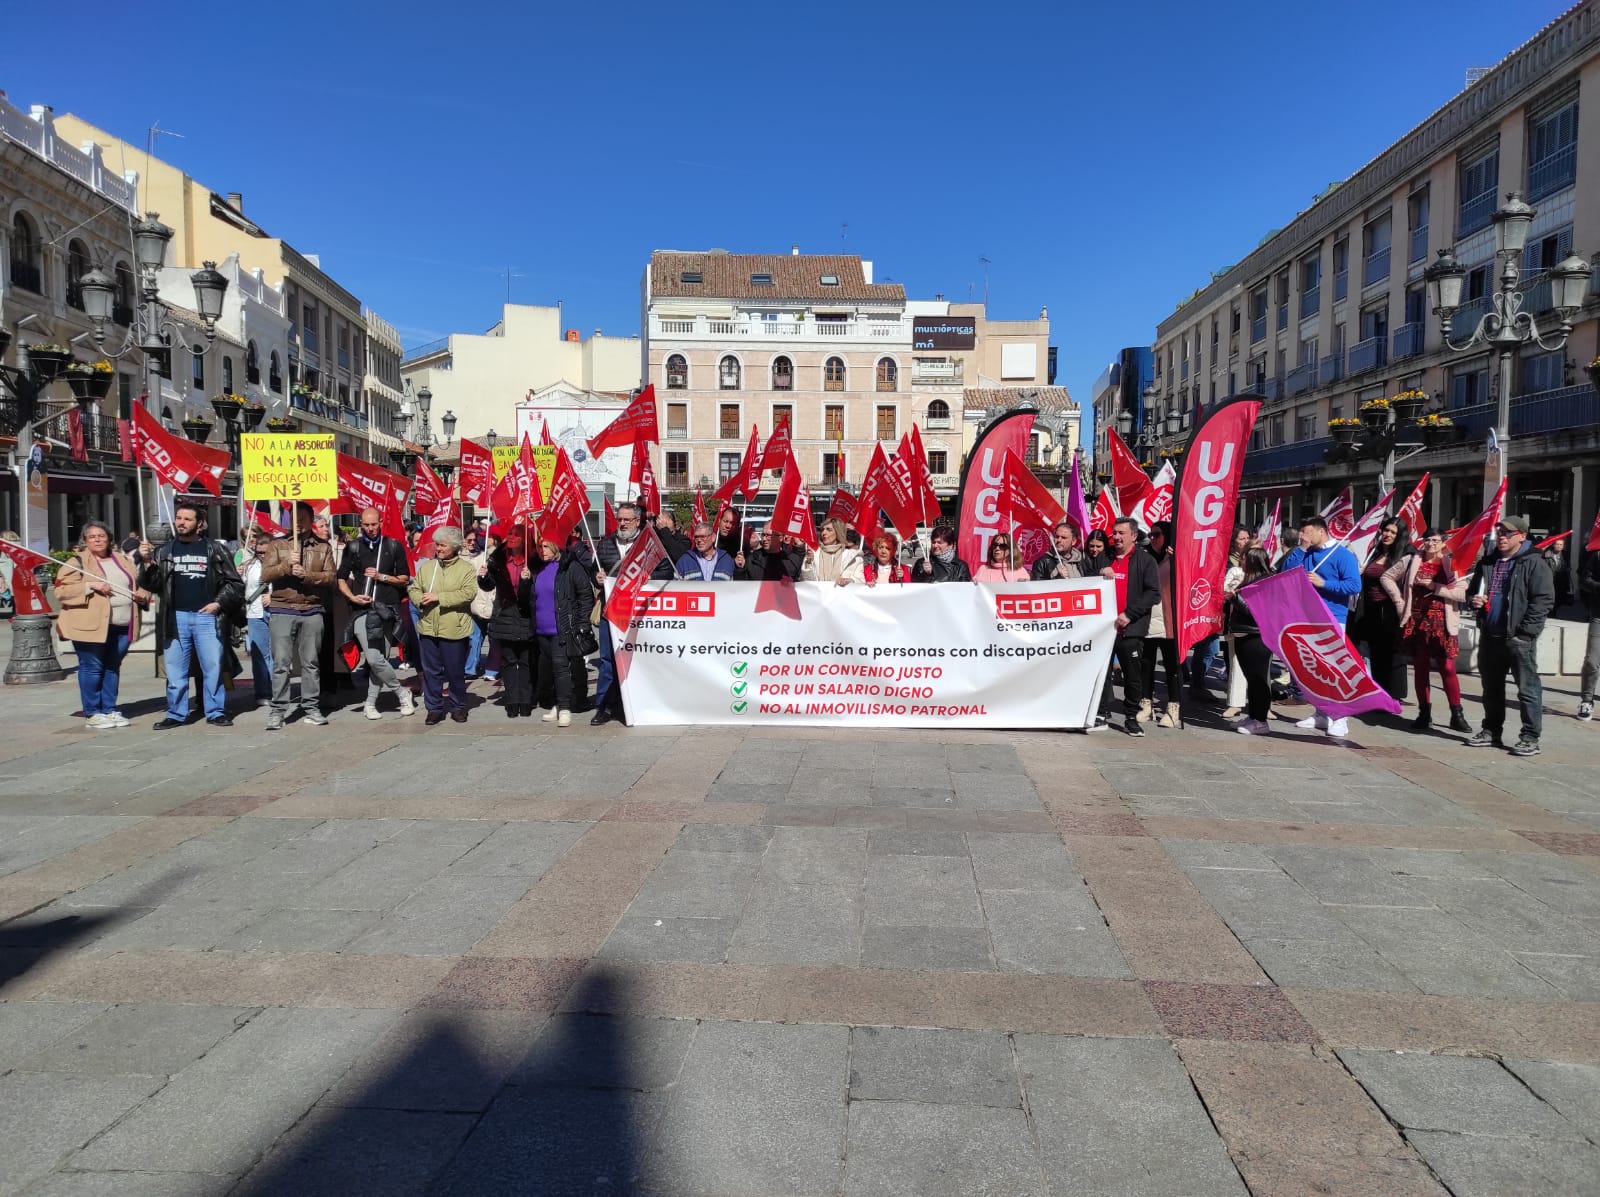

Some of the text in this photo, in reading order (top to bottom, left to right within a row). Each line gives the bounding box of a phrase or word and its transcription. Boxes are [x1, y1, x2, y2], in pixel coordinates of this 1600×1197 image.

[245, 438, 265, 450] NO
[270, 441, 276, 450] A
[280, 440, 292, 450] LA
[263, 454, 283, 467] N1
[297, 454, 317, 467] N2
[248, 469, 328, 483] NEGOCIACIÓN
[273, 483, 302, 497] N3
[973, 448, 1007, 562] UGT
[1193, 441, 1235, 568] UGT
[633, 597, 677, 611] COO
[1000, 598, 1062, 614] CCOO
[629, 618, 686, 630] señanza
[619, 638, 1092, 660] entros y servicios de atención a personas con discapacidad
[760, 664, 943, 681] POR UN CONVENIO JUSTO
[760, 684, 933, 698] POR UN SALARIO DIGNO
[759, 703, 987, 716] NO AL INMOVILISMO PATRONAL
